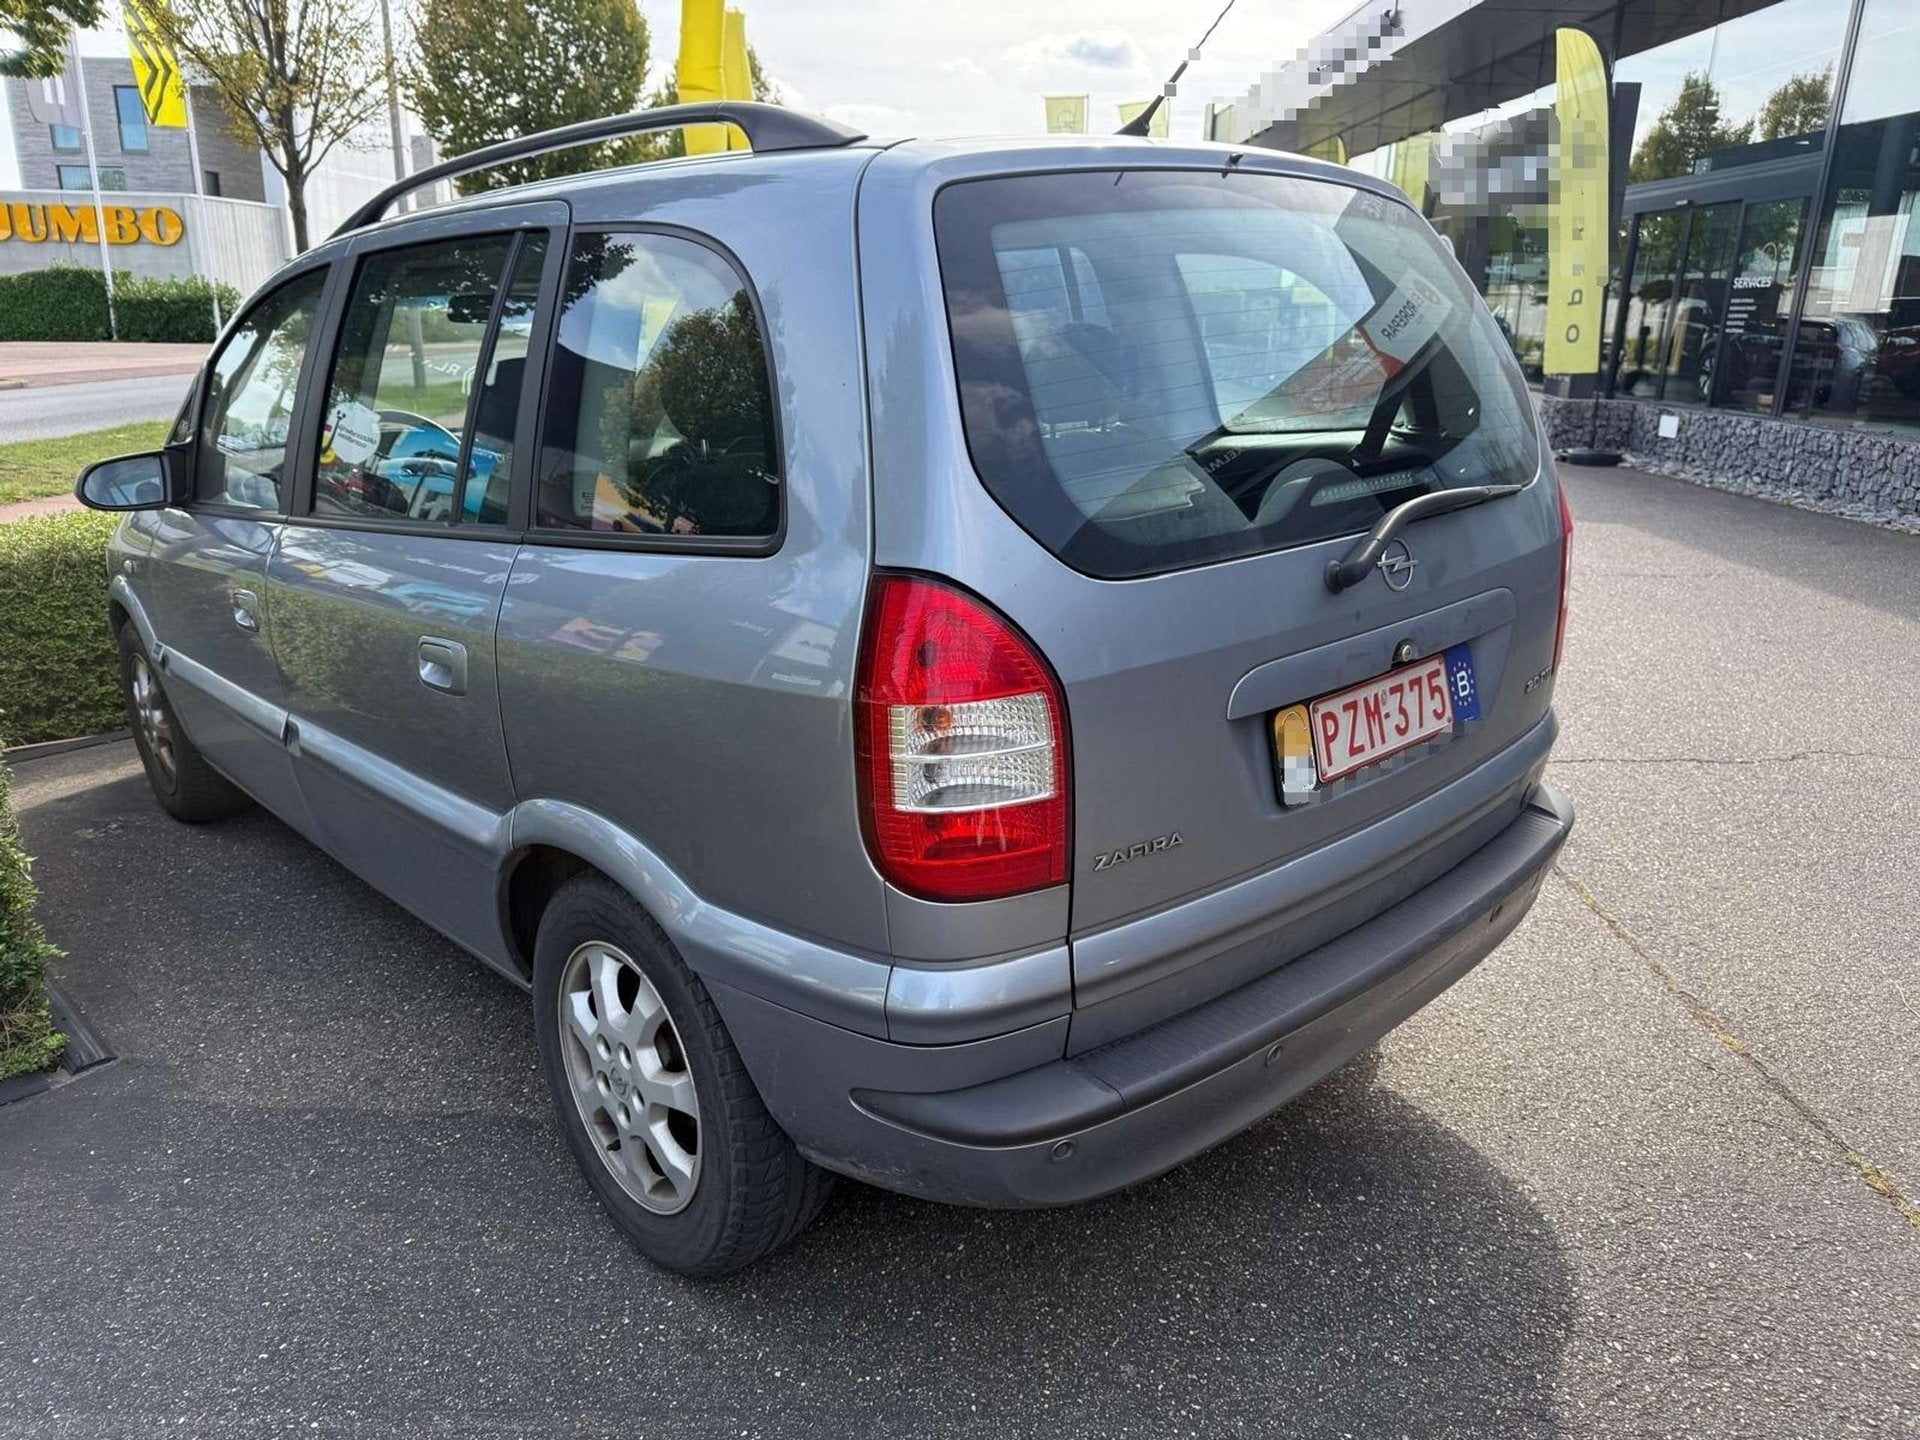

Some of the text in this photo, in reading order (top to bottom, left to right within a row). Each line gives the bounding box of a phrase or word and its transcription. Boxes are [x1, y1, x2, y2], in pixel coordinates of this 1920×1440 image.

[1732, 276, 1773, 290] SERVICES
[1456, 670, 1470, 698] B
[1320, 668, 1447, 768] PZM-375
[1093, 831, 1184, 872] ZAFIRA
